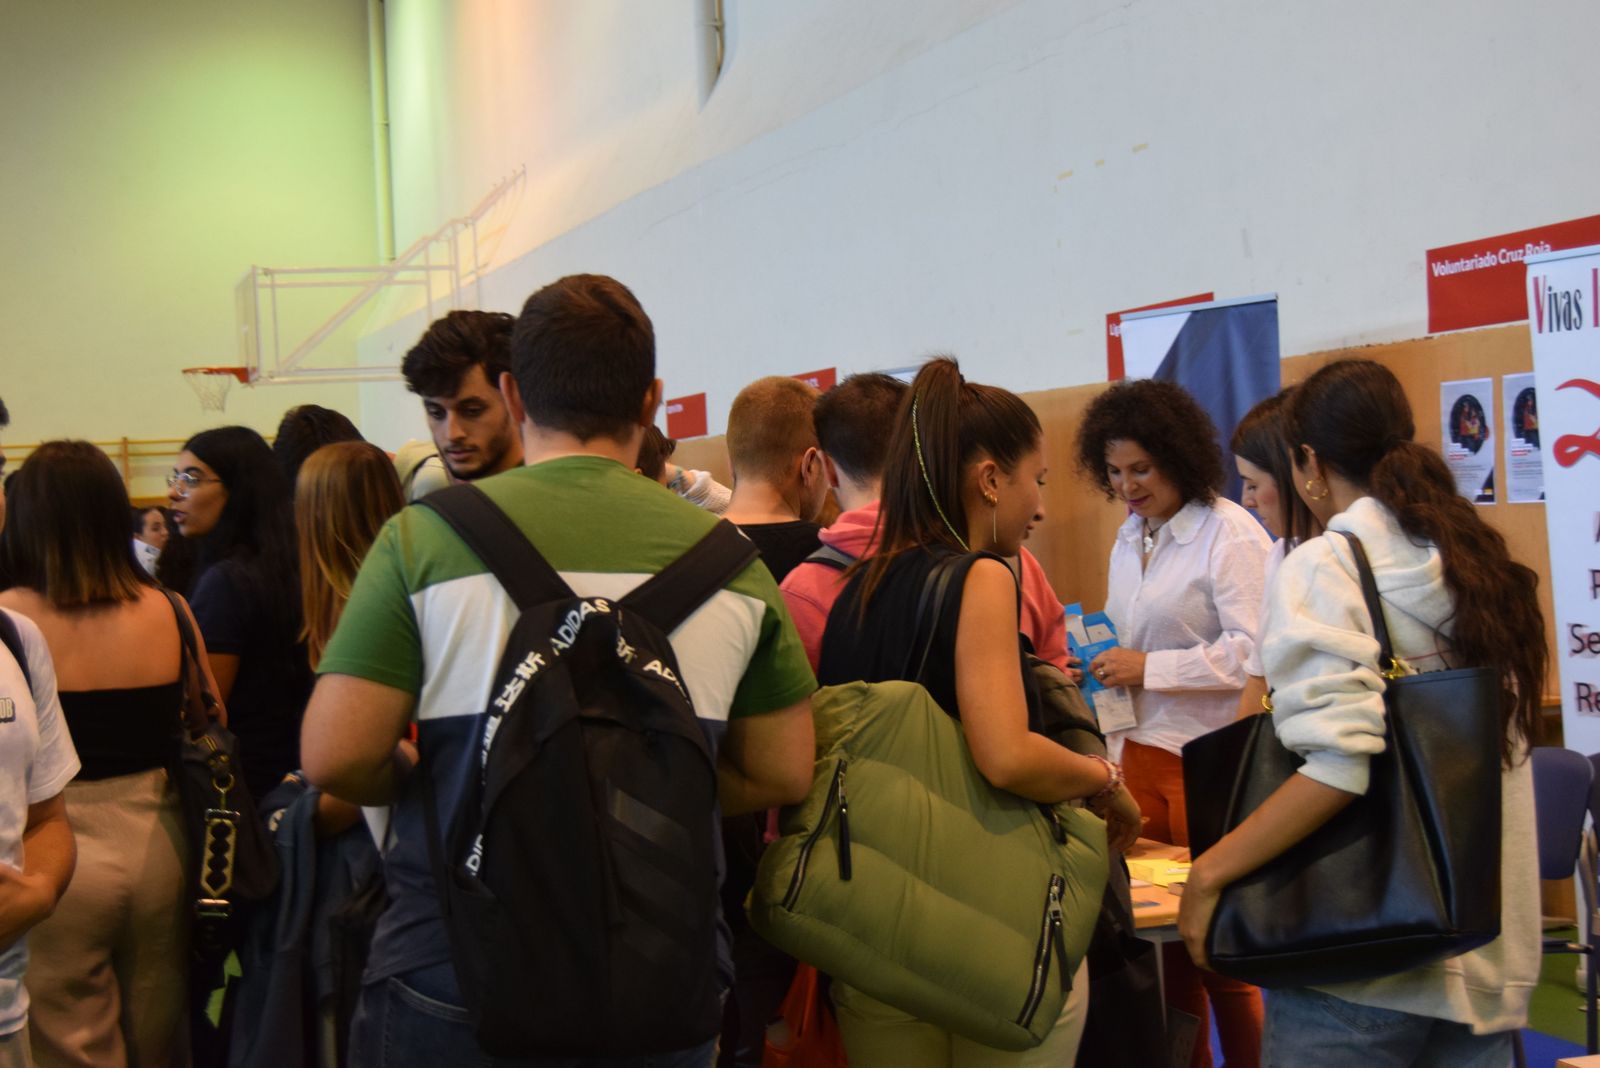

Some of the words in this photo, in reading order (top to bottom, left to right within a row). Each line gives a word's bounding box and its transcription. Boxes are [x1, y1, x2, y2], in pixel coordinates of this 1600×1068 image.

[1431, 251, 1499, 277] Voluntariado
[1498, 248, 1525, 264] Cruz
[1532, 274, 1583, 334] Vivas
[550, 598, 611, 656] ADIDAS
